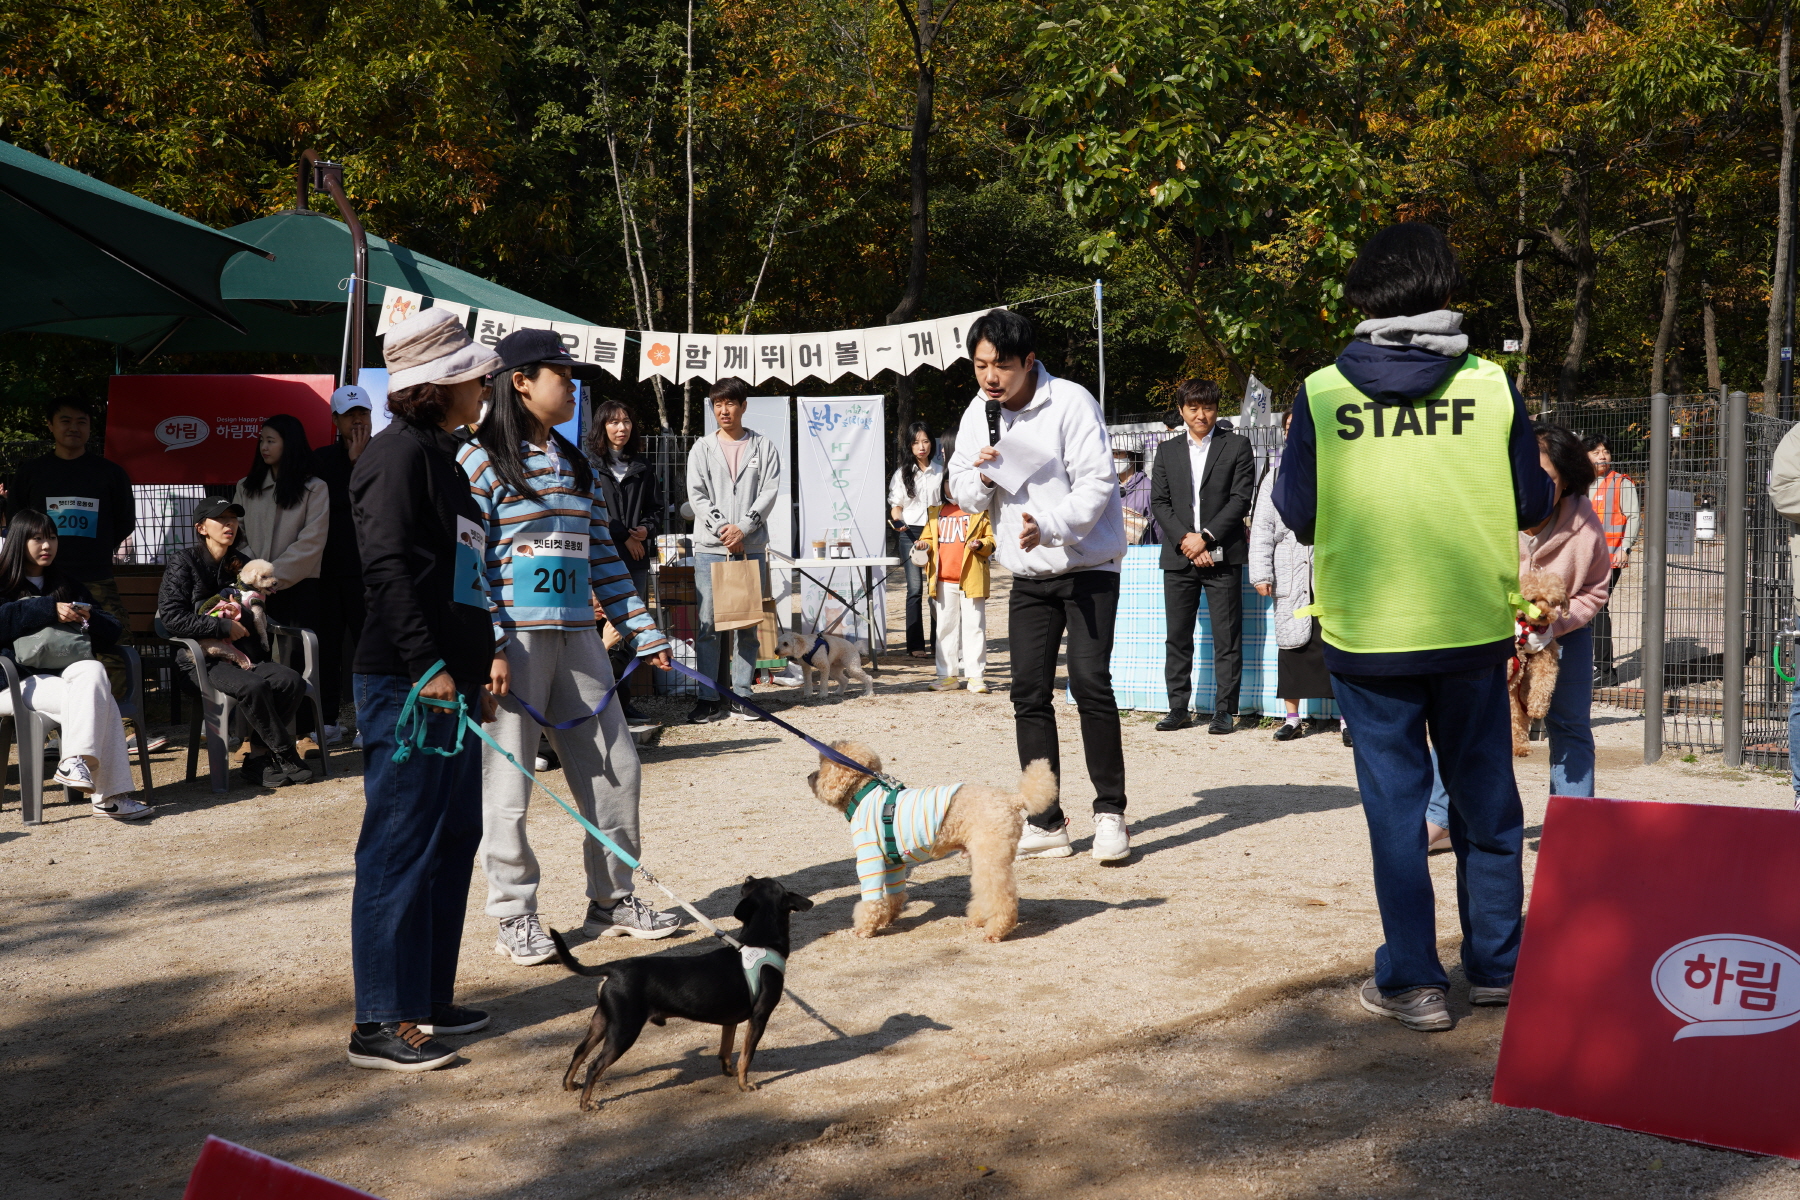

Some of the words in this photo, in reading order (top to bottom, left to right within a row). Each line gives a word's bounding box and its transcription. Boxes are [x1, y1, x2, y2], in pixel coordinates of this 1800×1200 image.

[1335, 398, 1476, 441] STAFF
[164, 422, 198, 440] 하림
[216, 424, 263, 439] 하림펫
[57, 515, 89, 530] 209
[533, 539, 563, 550] 펫티켓
[564, 540, 583, 552] 운동회
[533, 567, 576, 595] 201
[1684, 953, 1781, 1012] 하림
